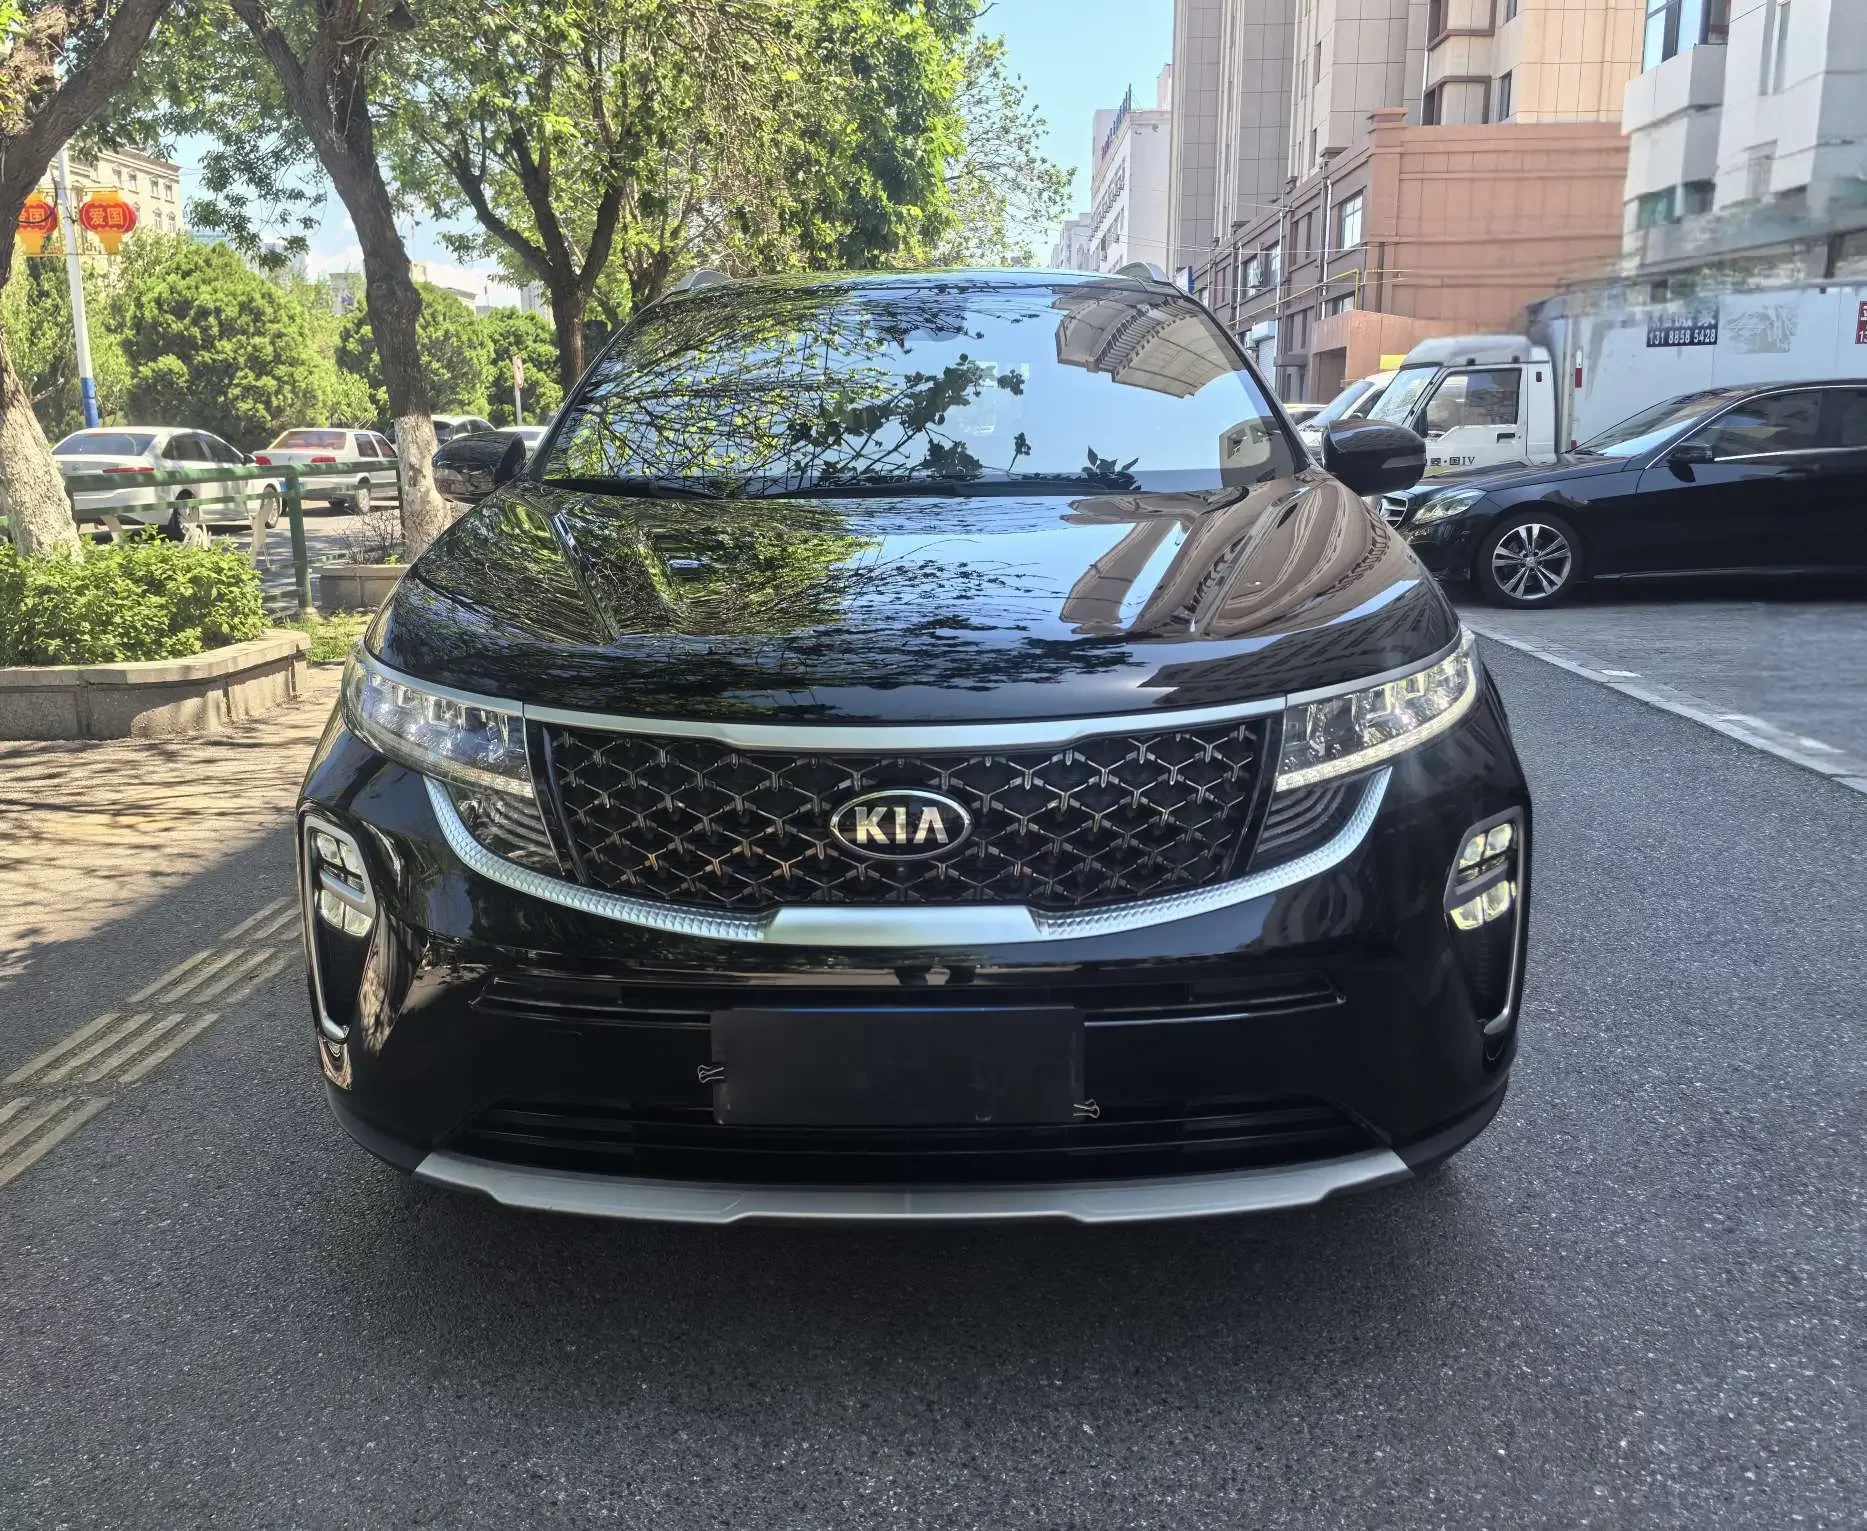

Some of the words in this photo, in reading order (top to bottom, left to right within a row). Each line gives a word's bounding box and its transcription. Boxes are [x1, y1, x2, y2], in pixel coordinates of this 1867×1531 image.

[89, 207, 124, 226] 爱国
[1649, 331, 1665, 345] 131
[1693, 329, 1716, 343] 5428
[855, 806, 949, 844] KIA
